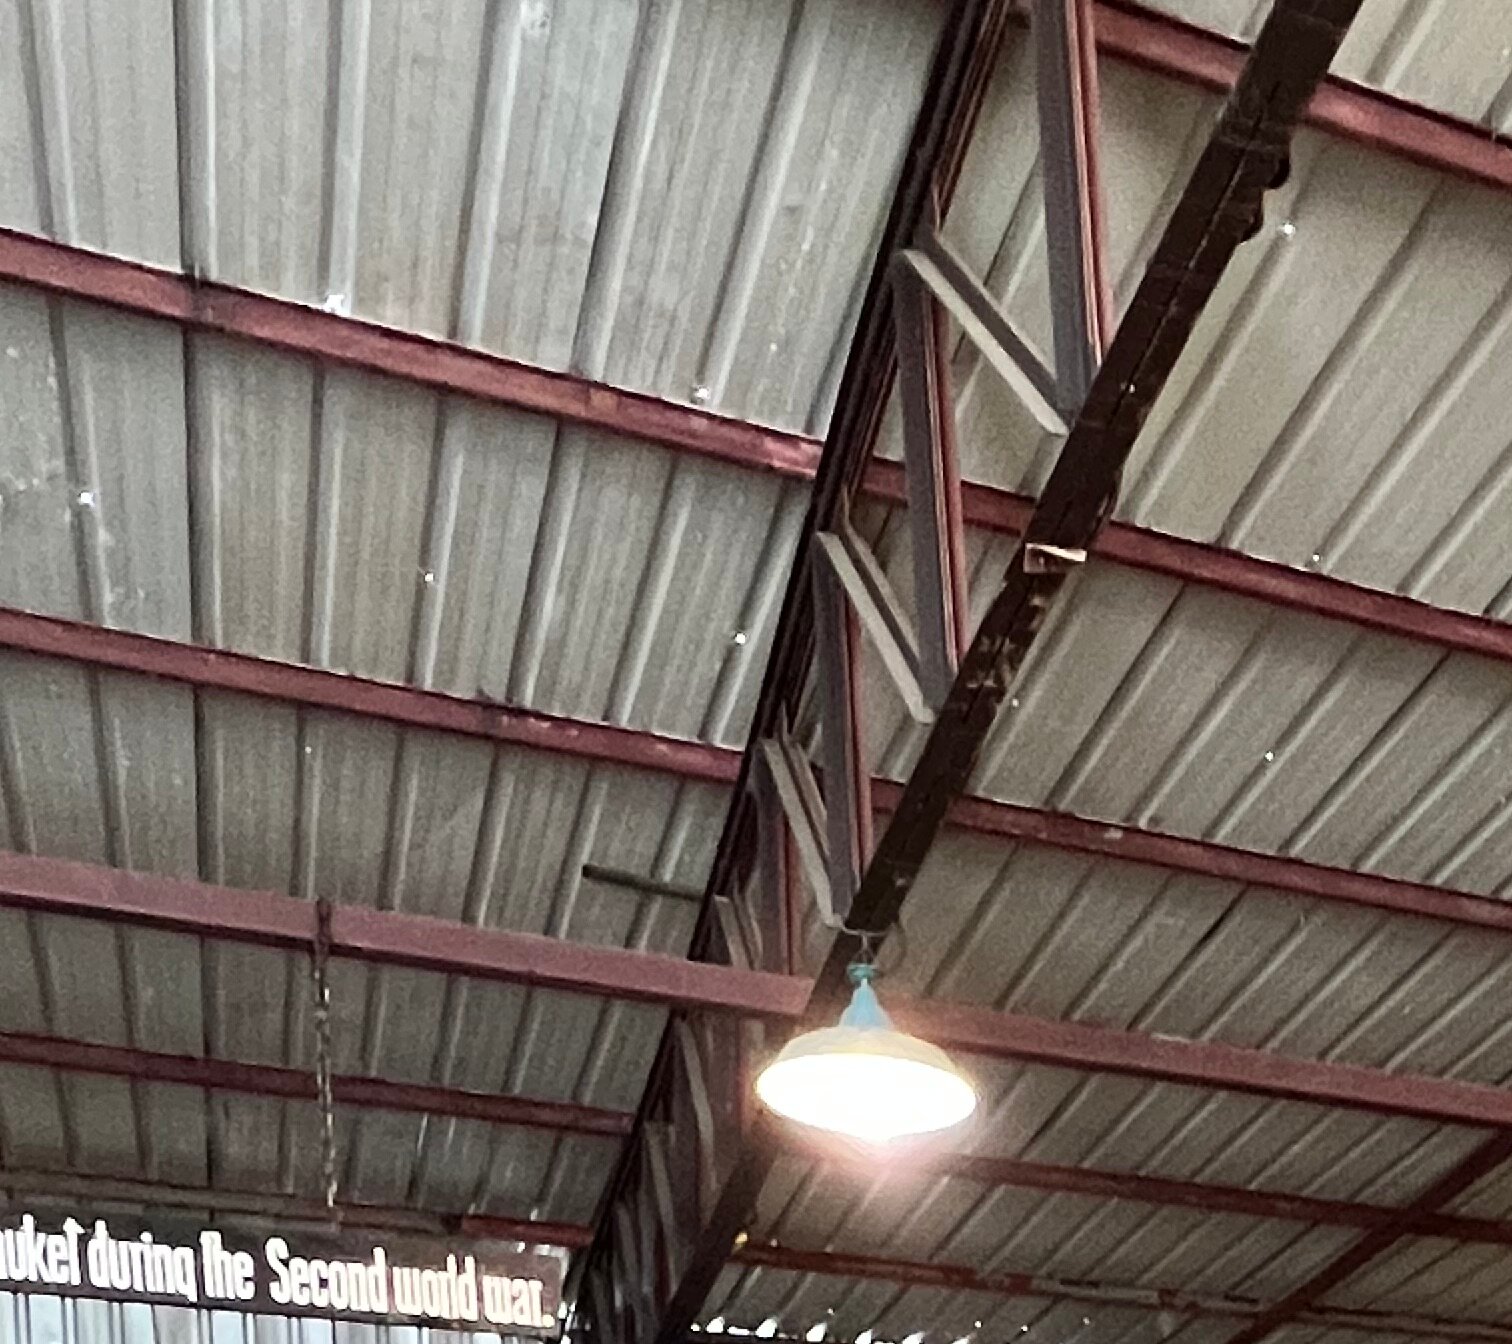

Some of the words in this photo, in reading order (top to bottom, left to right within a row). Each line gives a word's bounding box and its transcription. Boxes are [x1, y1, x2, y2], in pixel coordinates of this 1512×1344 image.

[87, 1218, 198, 1304] during
[199, 1230, 256, 1301] the
[263, 1236, 389, 1314] Second
[393, 1253, 479, 1321] world
[482, 1274, 556, 1329] war.
